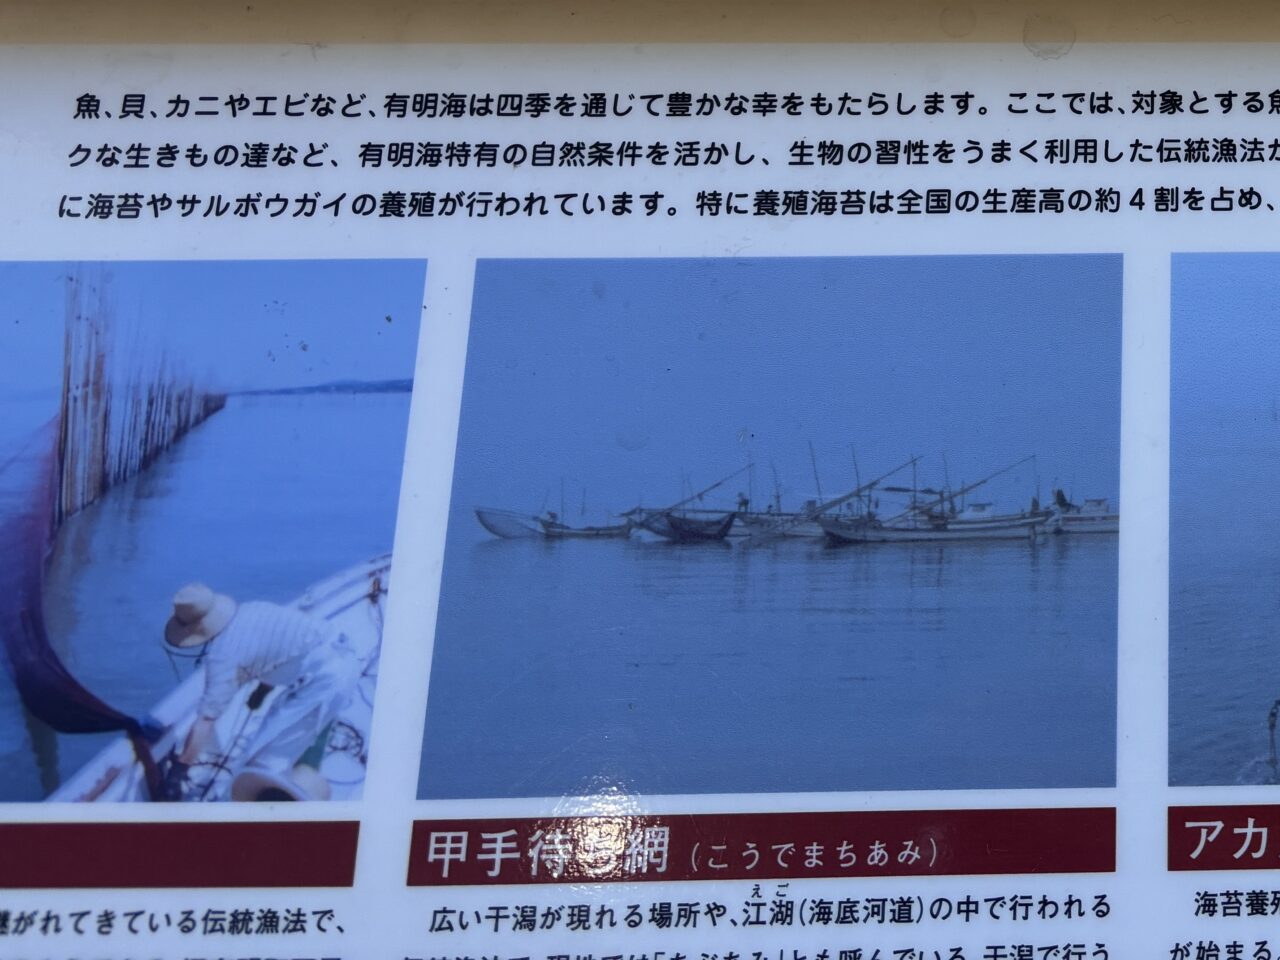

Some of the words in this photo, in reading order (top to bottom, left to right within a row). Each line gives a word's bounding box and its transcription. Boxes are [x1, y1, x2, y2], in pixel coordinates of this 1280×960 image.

[751, 883, 789, 898] えご
[429, 893, 1112, 933] 広い干潟が現れる場所や、江湖(海底河道)の中で行われる
